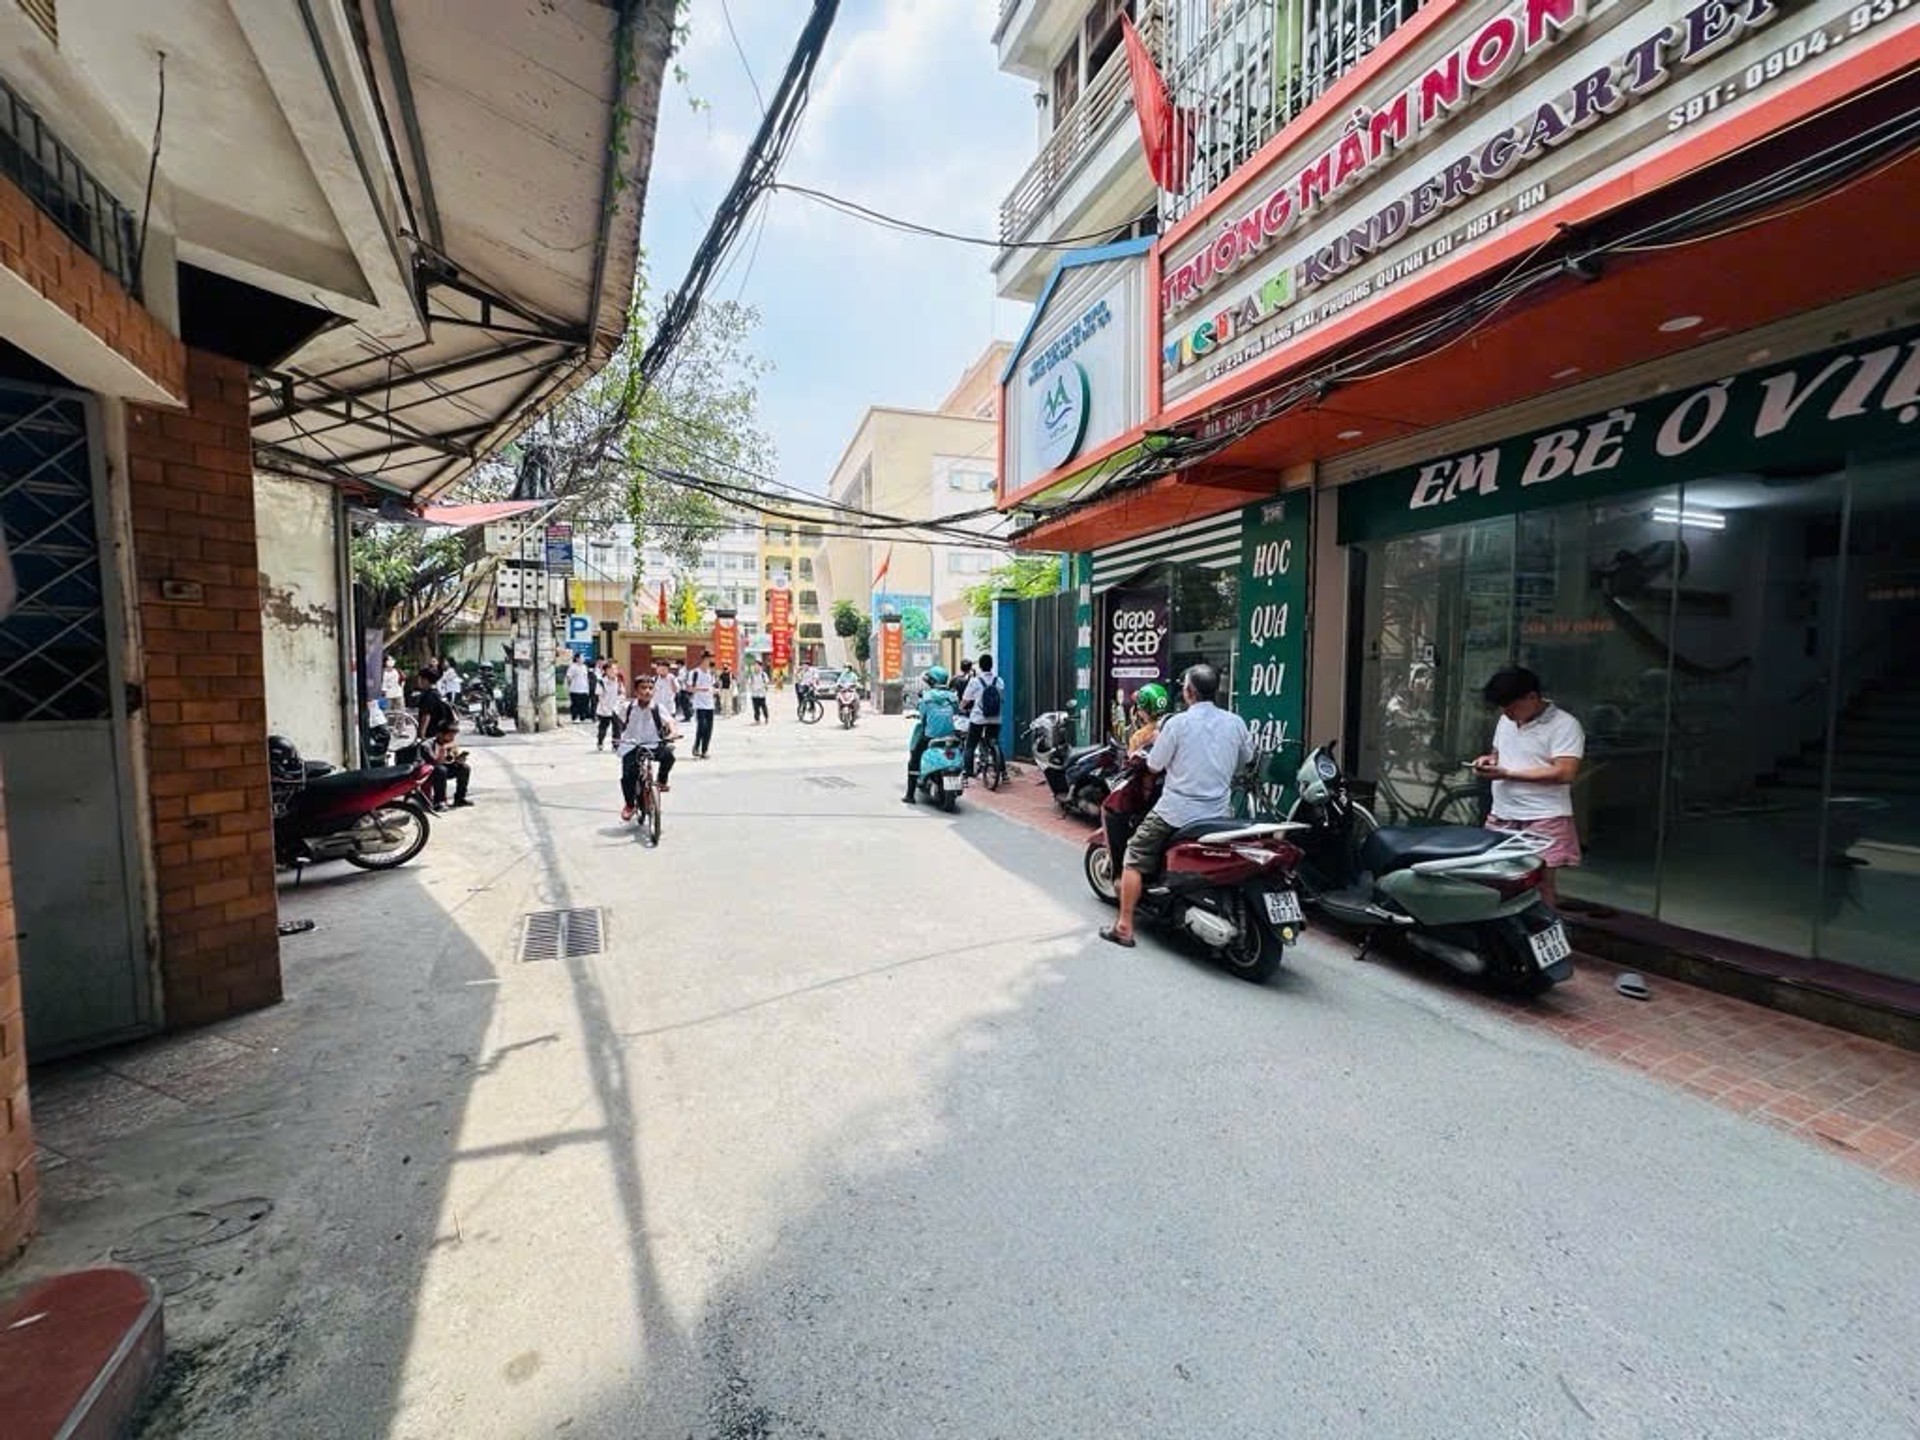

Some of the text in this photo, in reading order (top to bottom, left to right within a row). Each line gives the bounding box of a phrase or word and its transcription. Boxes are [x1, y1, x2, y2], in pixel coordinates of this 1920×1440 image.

[1466, 211, 1499, 240] HBT
[1518, 183, 1546, 213] HN
[1409, 447, 1500, 510] EM
[1252, 539, 1292, 587] HỌC
[570, 617, 589, 640] P
[1111, 630, 1160, 656] SEED
[1112, 608, 1156, 633] Grape
[1250, 602, 1288, 649] QUA
[1250, 654, 1286, 697] ĐÔI
